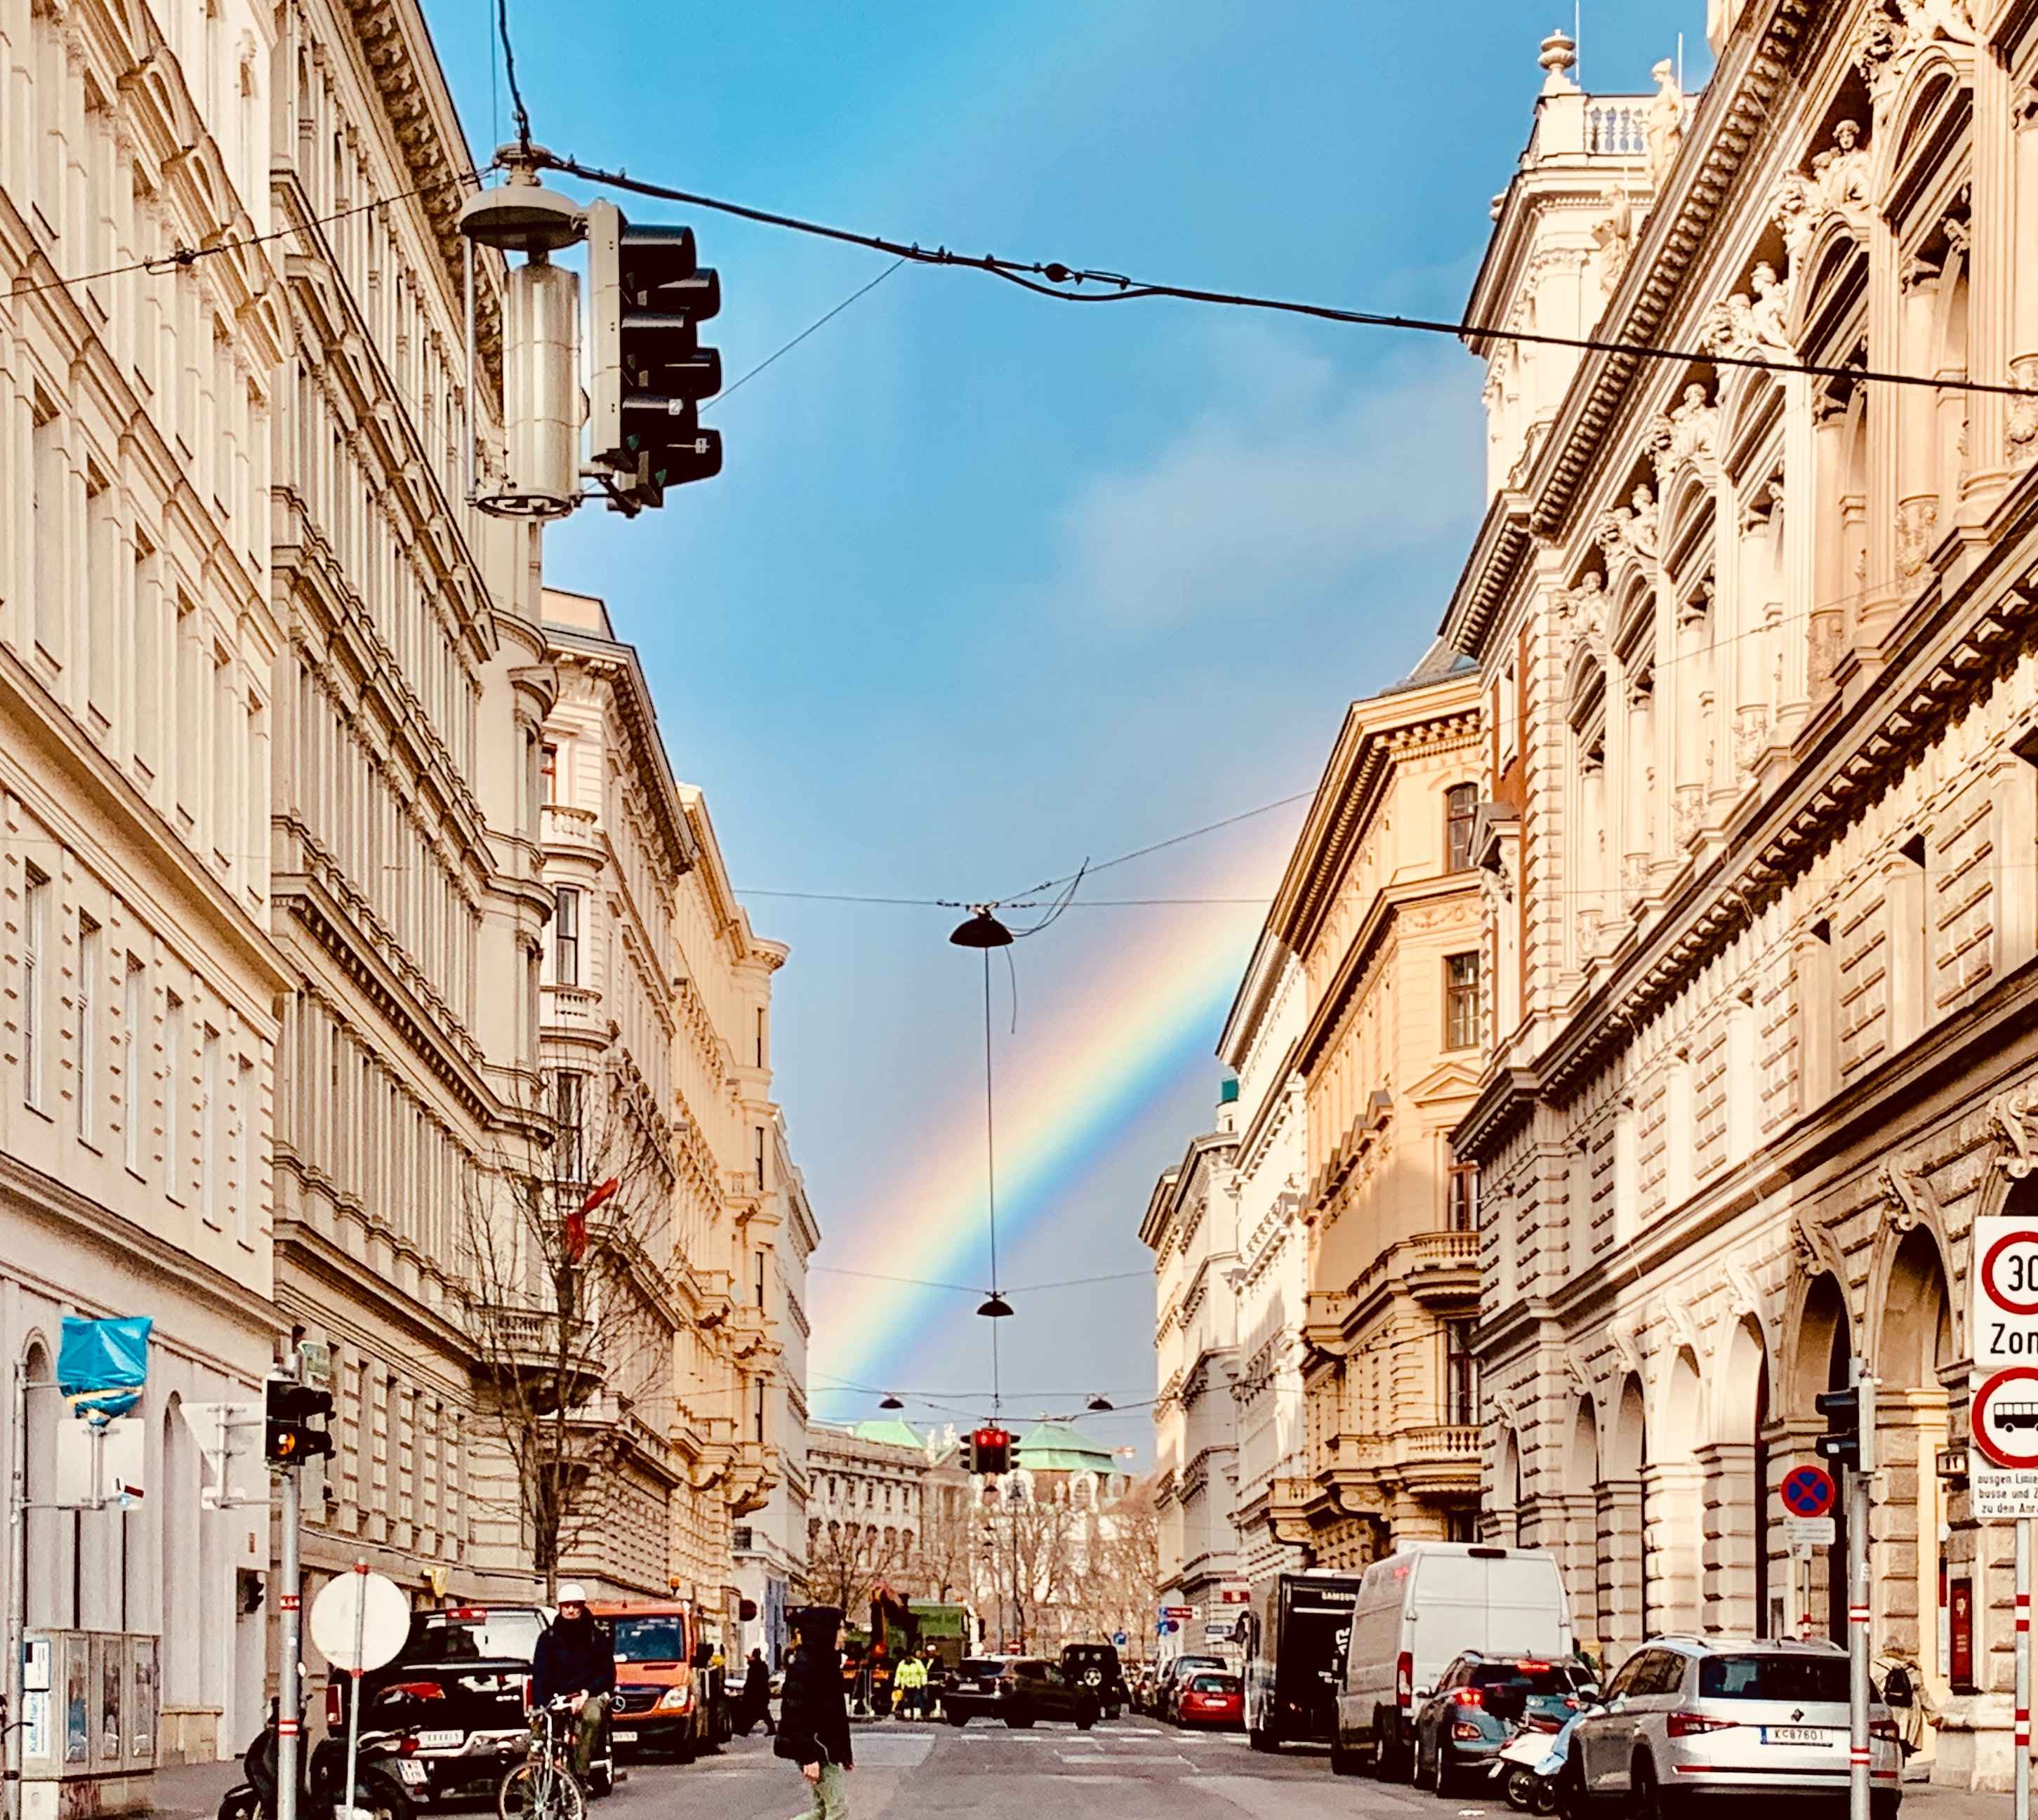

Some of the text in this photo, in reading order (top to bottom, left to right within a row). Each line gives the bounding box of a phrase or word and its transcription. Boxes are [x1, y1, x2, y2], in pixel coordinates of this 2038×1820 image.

[2007, 1254, 2038, 1291] 30
[1990, 1322, 2038, 1354] Zon
[1978, 1488, 2006, 1499] busse
[2011, 1489, 2030, 1499] und
[1981, 1505, 1993, 1513] zu
[1997, 1503, 2015, 1513] den
